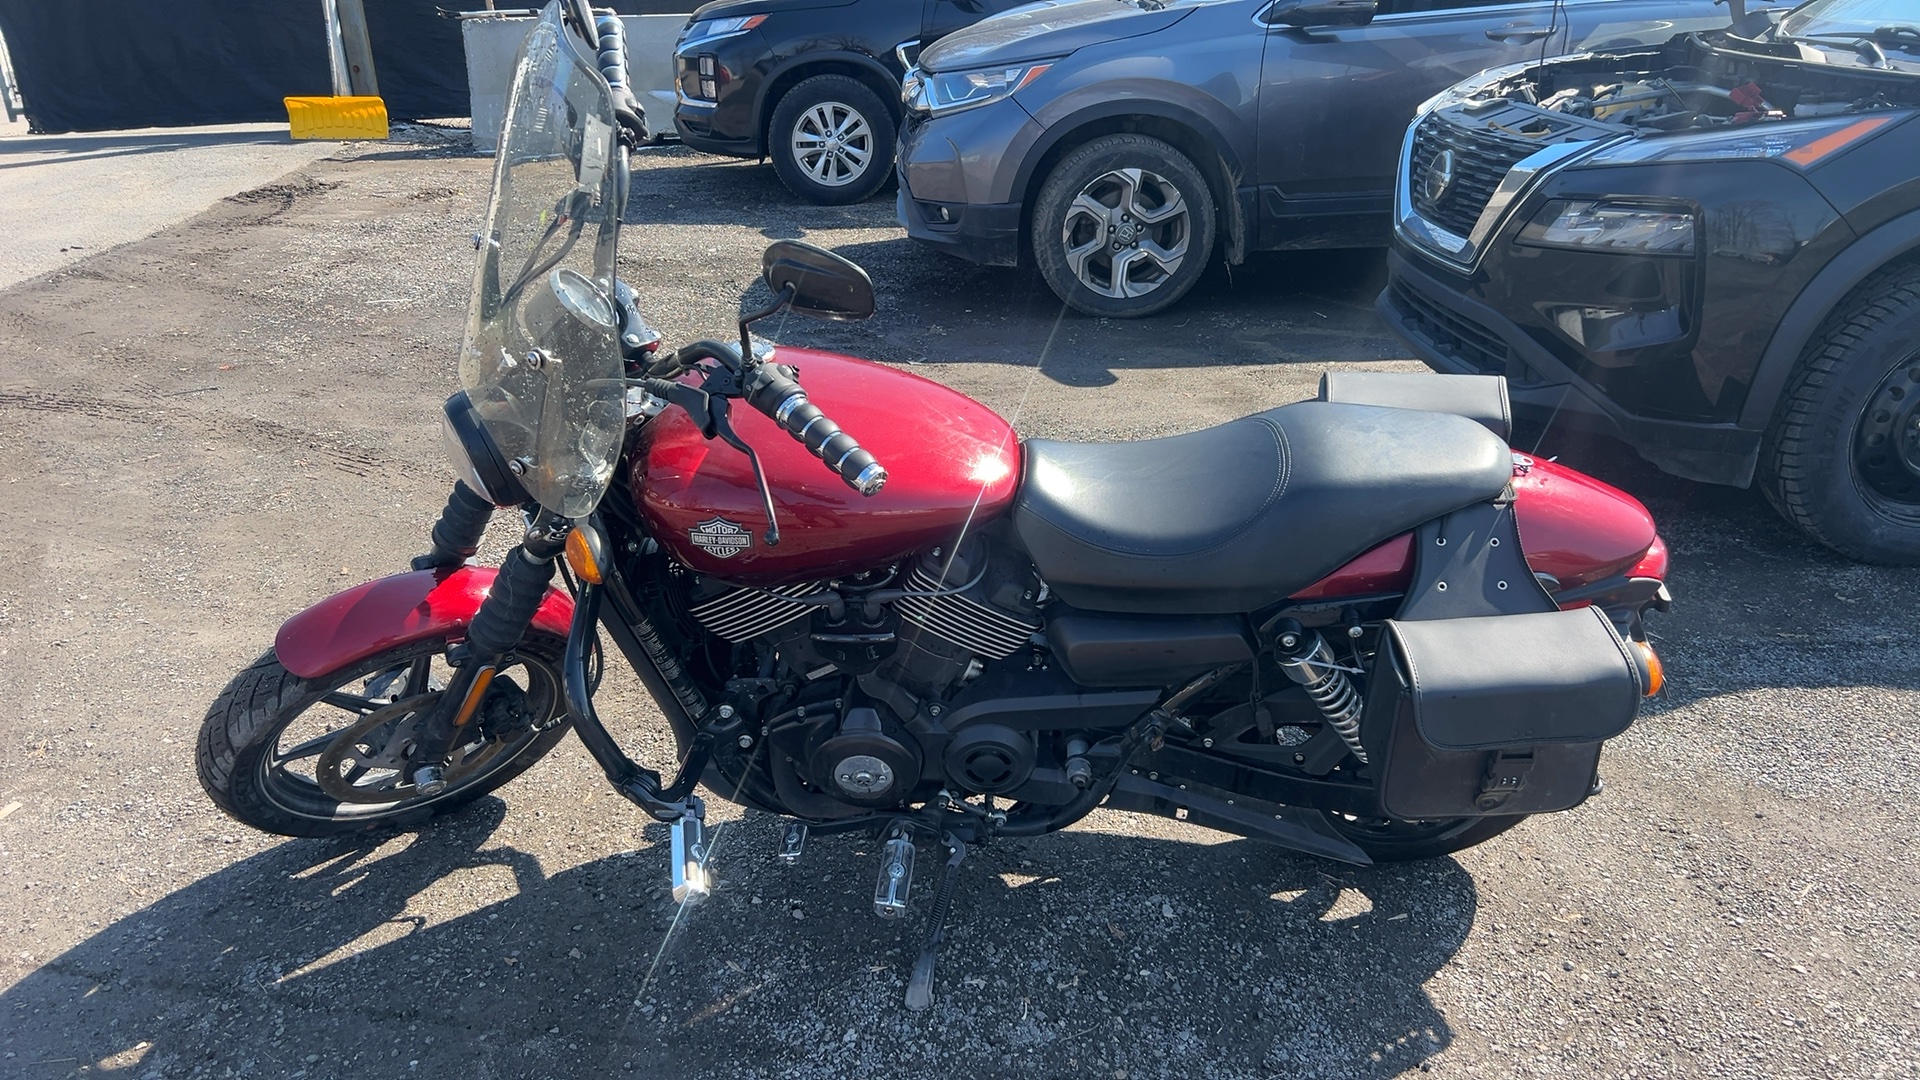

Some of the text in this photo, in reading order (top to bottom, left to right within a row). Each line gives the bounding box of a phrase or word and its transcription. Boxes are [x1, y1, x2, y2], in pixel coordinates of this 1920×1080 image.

[705, 524, 734, 534] MOTOR
[694, 535, 747, 545] HARLEY-DAVIDSON
[707, 546, 735, 556] CYCLES
